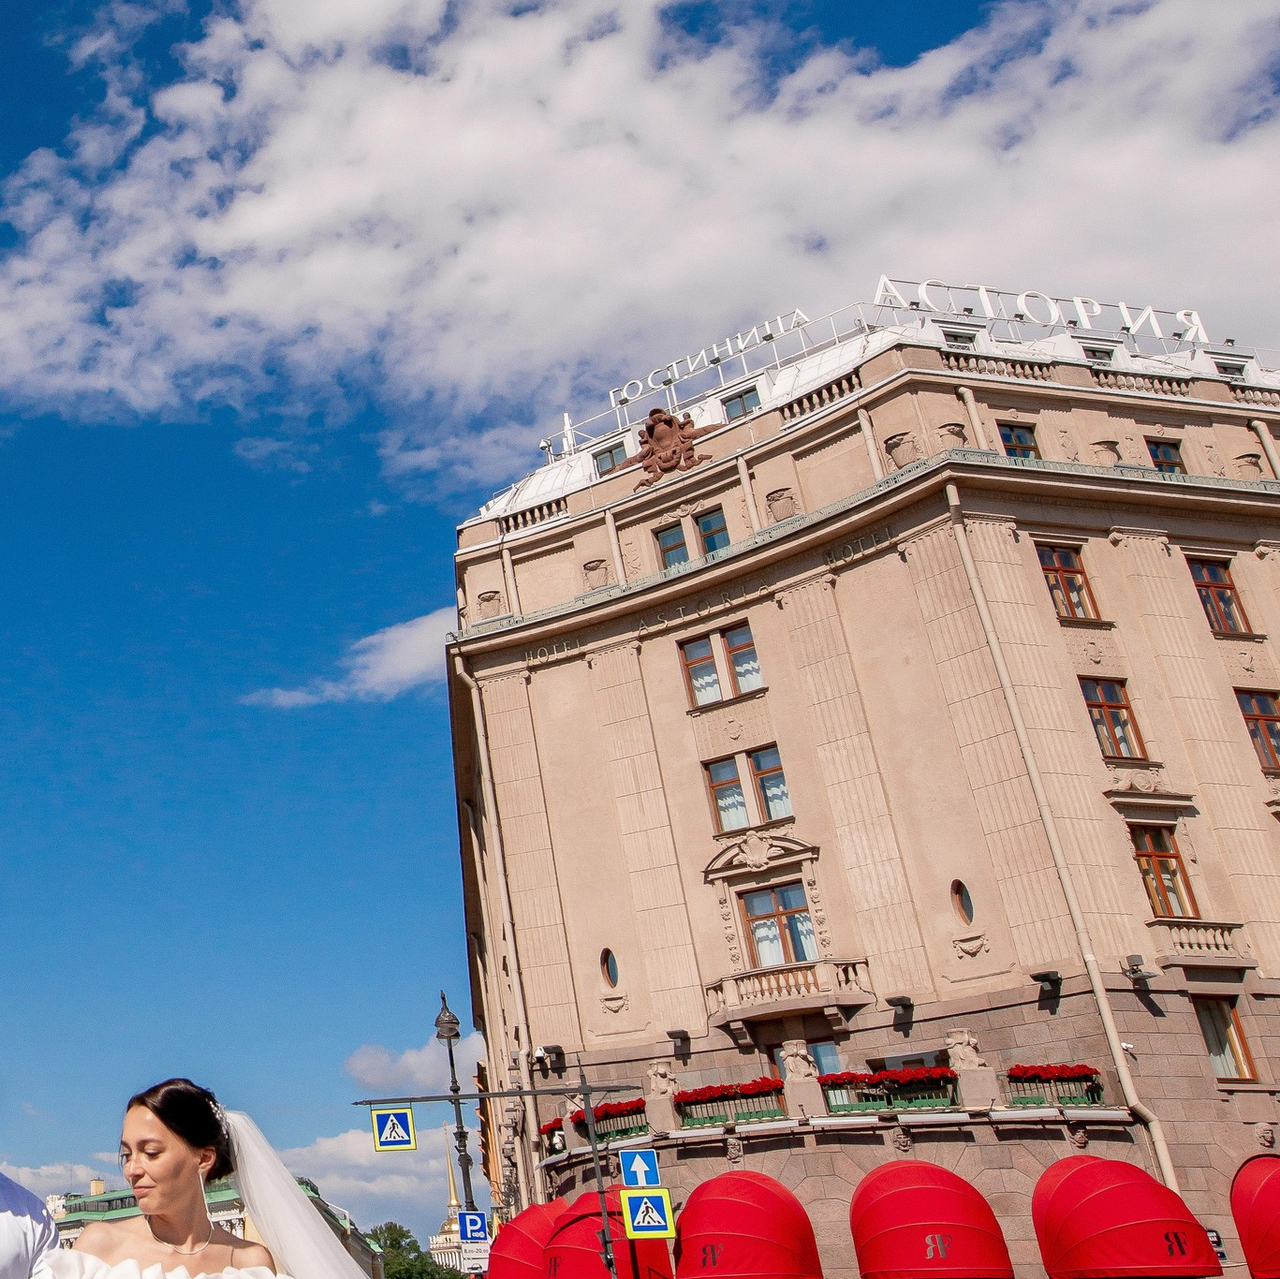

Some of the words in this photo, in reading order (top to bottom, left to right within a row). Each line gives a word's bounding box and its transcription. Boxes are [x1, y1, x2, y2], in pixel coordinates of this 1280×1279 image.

[609, 308, 810, 408] ГОСТИНИЦА
[873, 274, 1210, 344] АСТОРИЯ
[524, 639, 582, 665] HOTEL
[638, 579, 771, 634] ASTORIA
[826, 527, 899, 567] HOTEL
